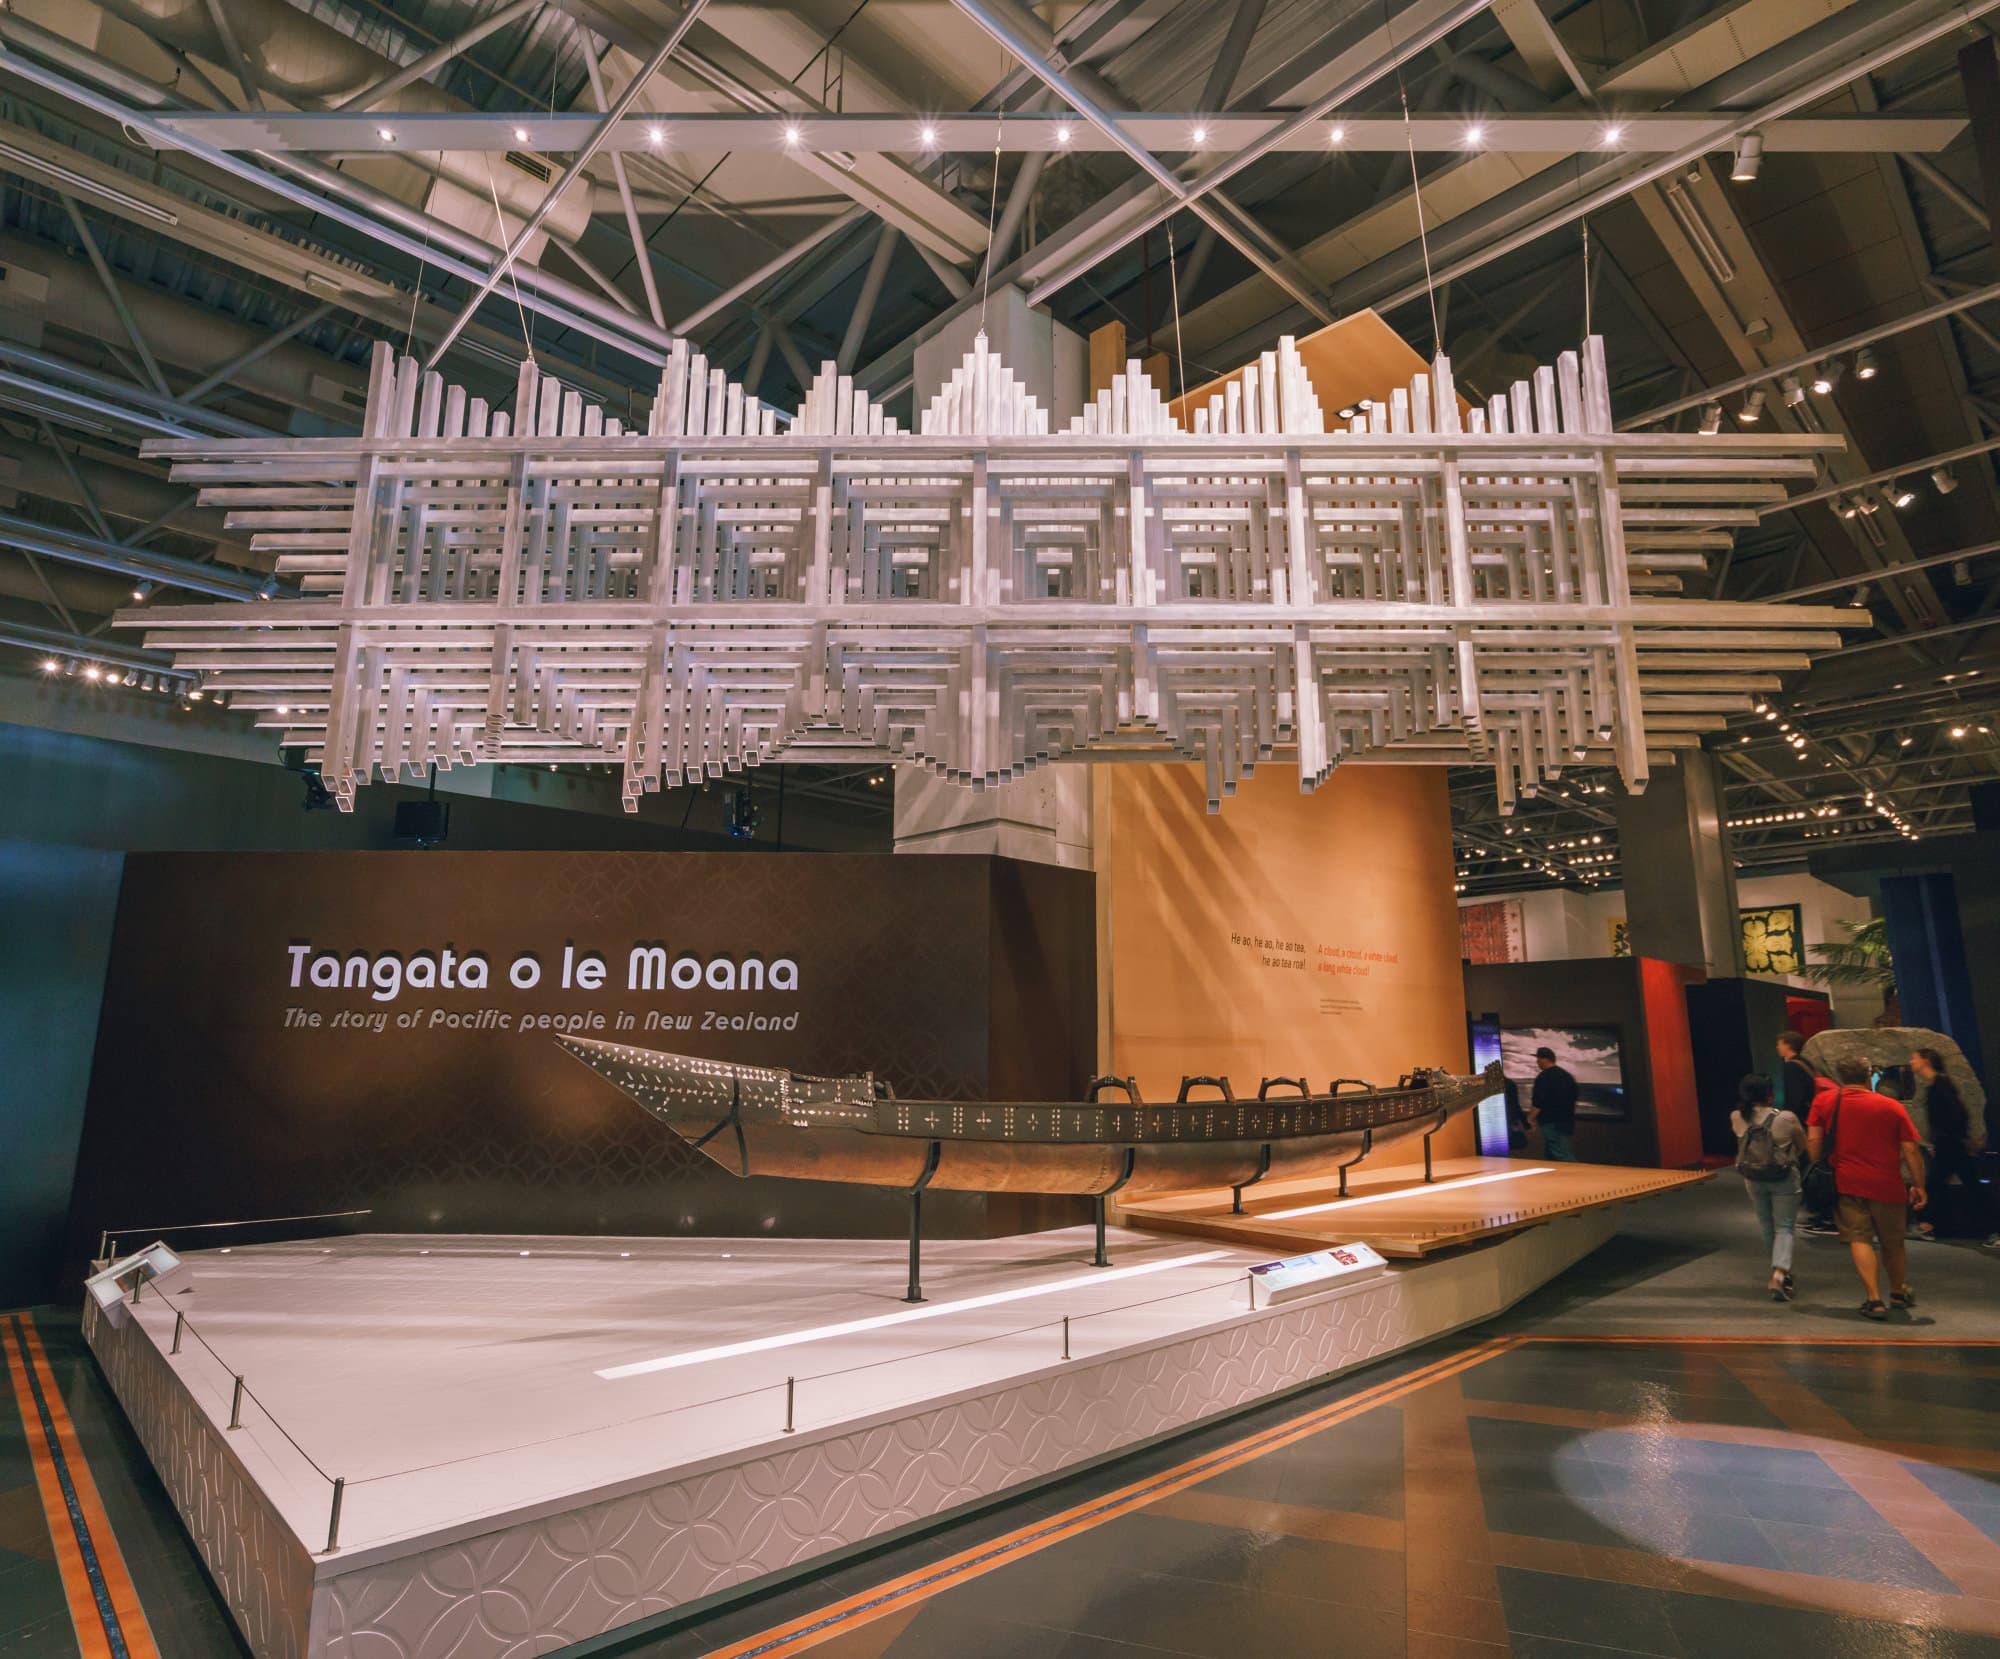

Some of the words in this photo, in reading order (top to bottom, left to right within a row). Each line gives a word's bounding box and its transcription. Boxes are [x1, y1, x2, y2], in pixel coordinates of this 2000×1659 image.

[1231, 932, 1241, 945] He
[288, 946, 489, 1001] Tangata
[509, 957, 541, 989] o
[561, 946, 607, 990] le
[627, 947, 799, 991] Moana
[284, 1008, 323, 1028] The
[330, 1008, 388, 1033] story
[396, 1008, 424, 1028] of
[428, 1008, 513, 1029] Pacific
[518, 1010, 606, 1033] people
[615, 1010, 636, 1030] in
[644, 1010, 693, 1030] New
[700, 1010, 800, 1031] Zealand
